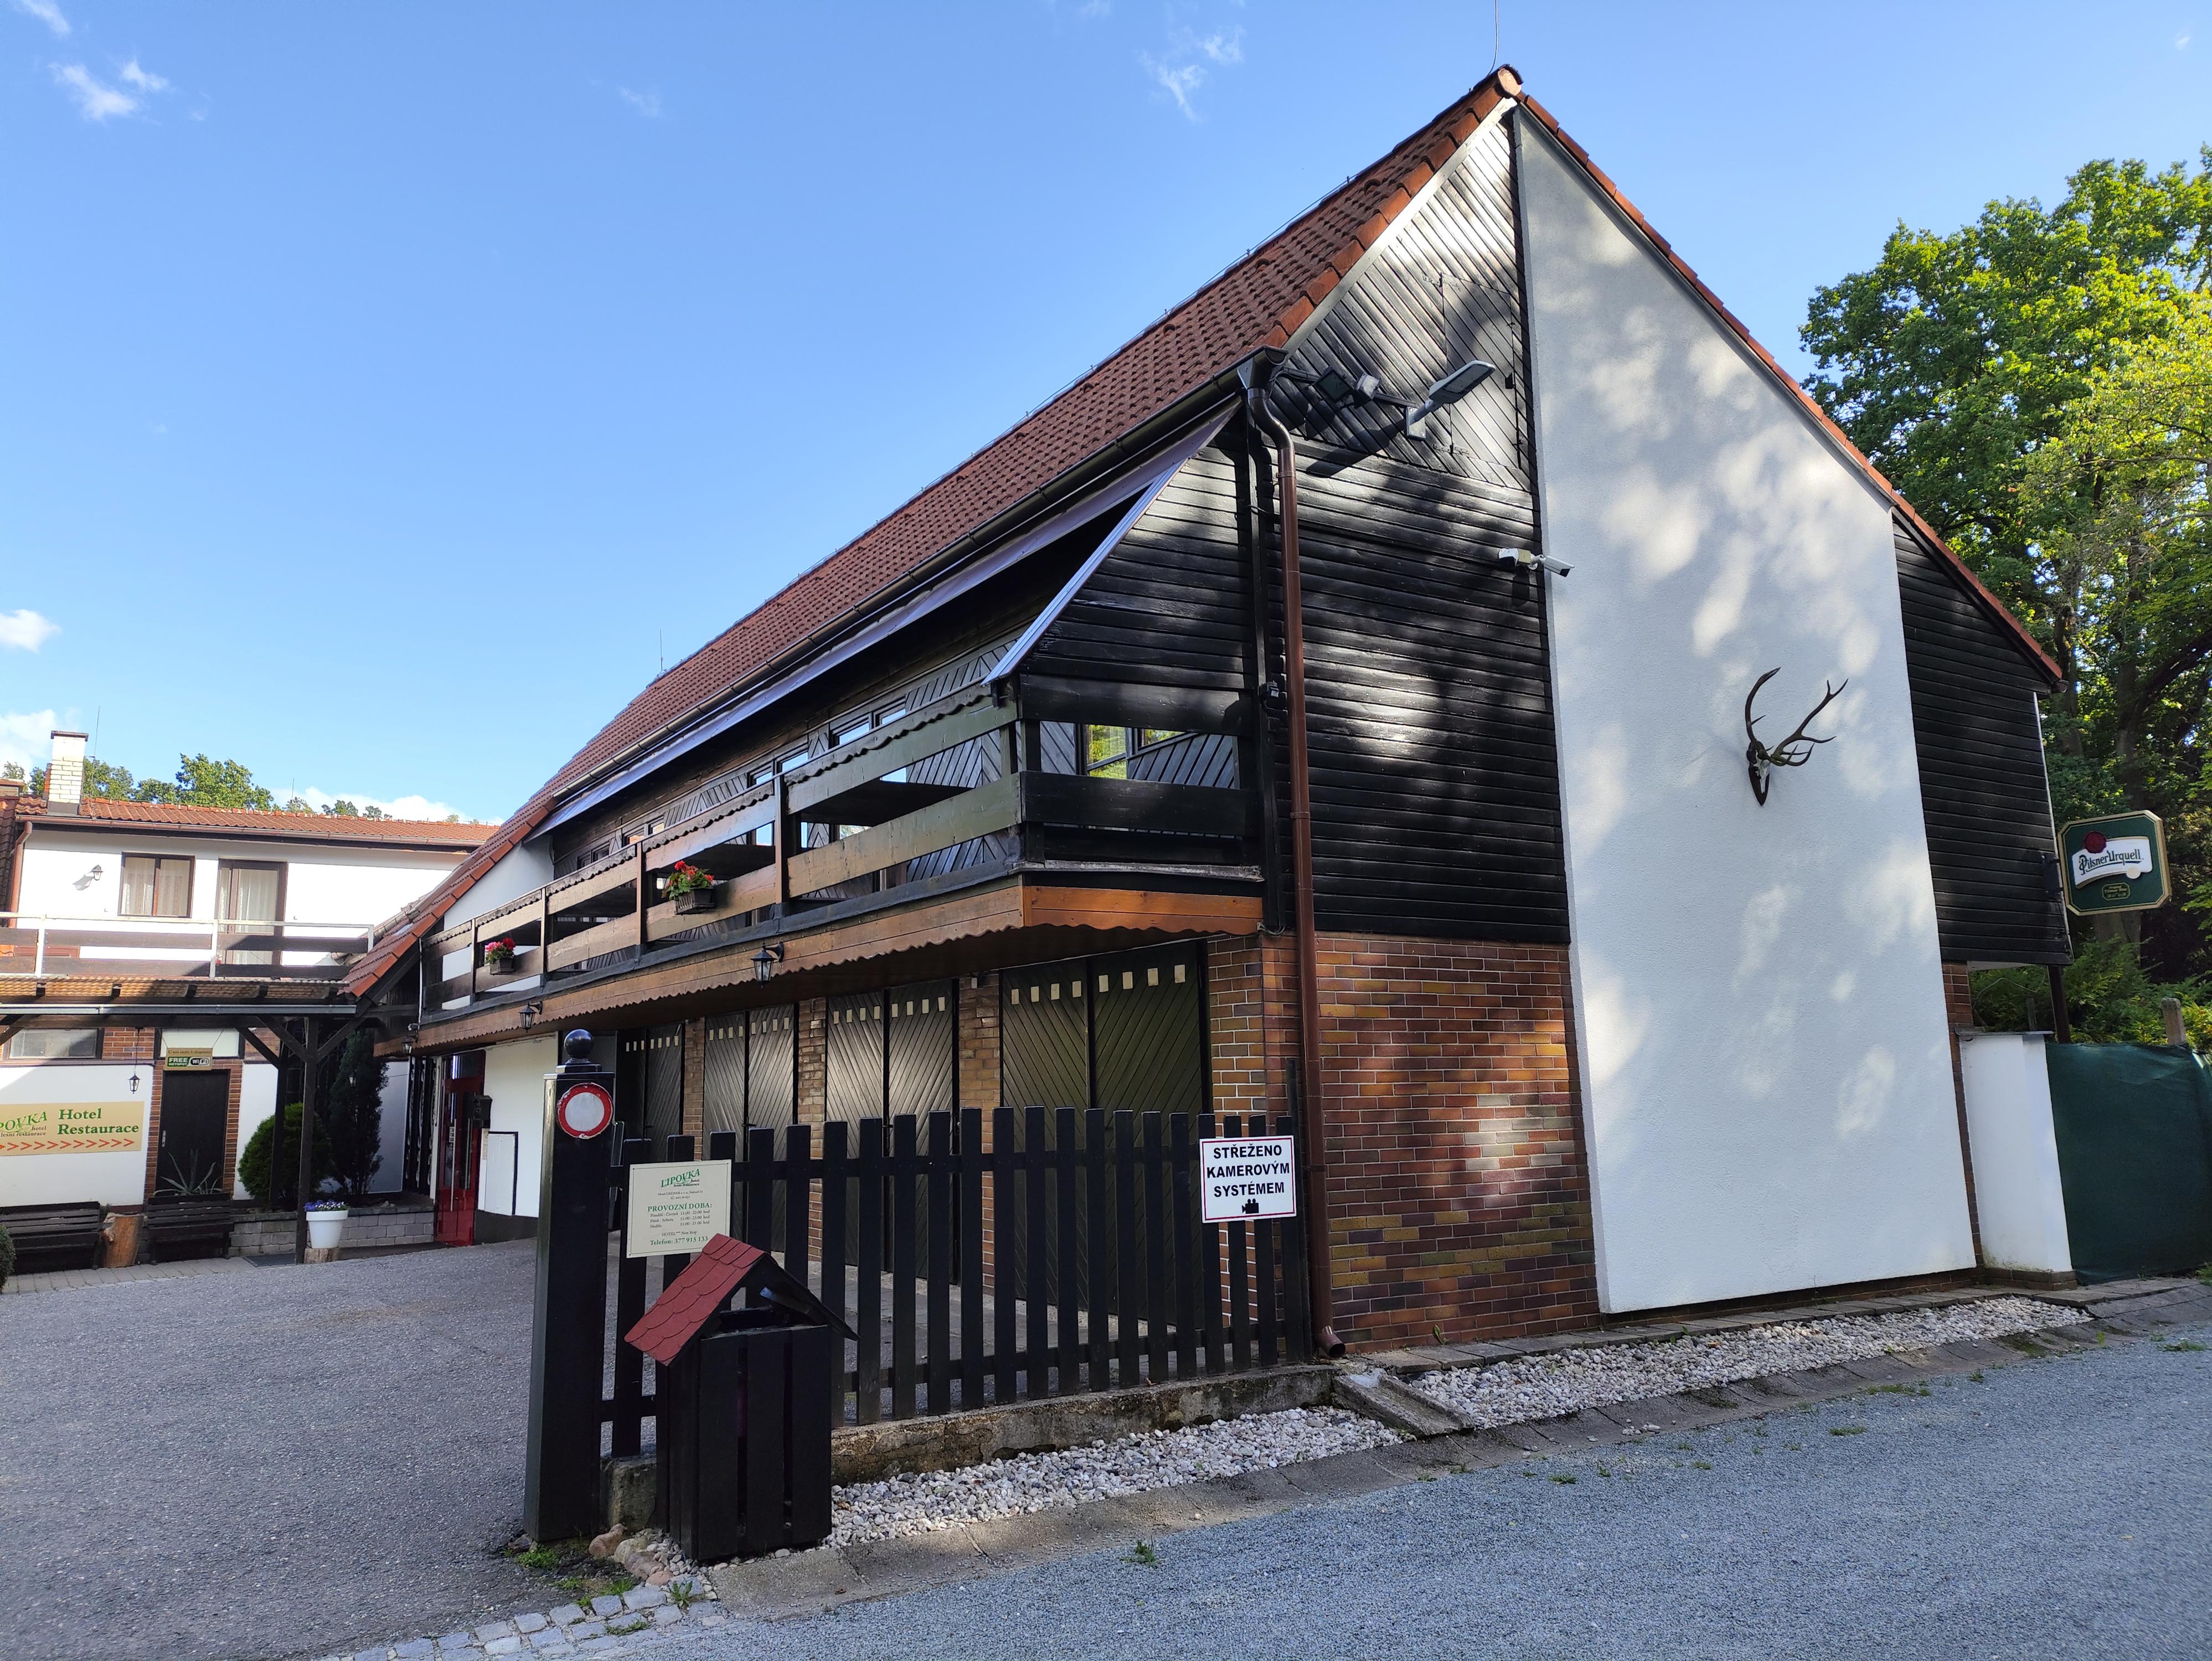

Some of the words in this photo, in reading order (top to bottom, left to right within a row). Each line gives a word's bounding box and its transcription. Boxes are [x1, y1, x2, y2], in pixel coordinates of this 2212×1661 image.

[2079, 854, 2108, 875] Pilsner
[2107, 849, 2141, 865] Urquell
[58, 1108, 101, 1120] Hotel
[57, 1124, 139, 1134] Restaurace
[1213, 1143, 1282, 1159] STŘEŽENO
[1206, 1160, 1290, 1178] KAMEROVÝM
[661, 1168, 700, 1188] LIPOVKA
[1214, 1181, 1285, 1197] SYSTÉMEM
[648, 1203, 687, 1212] PROVOZNÍ
